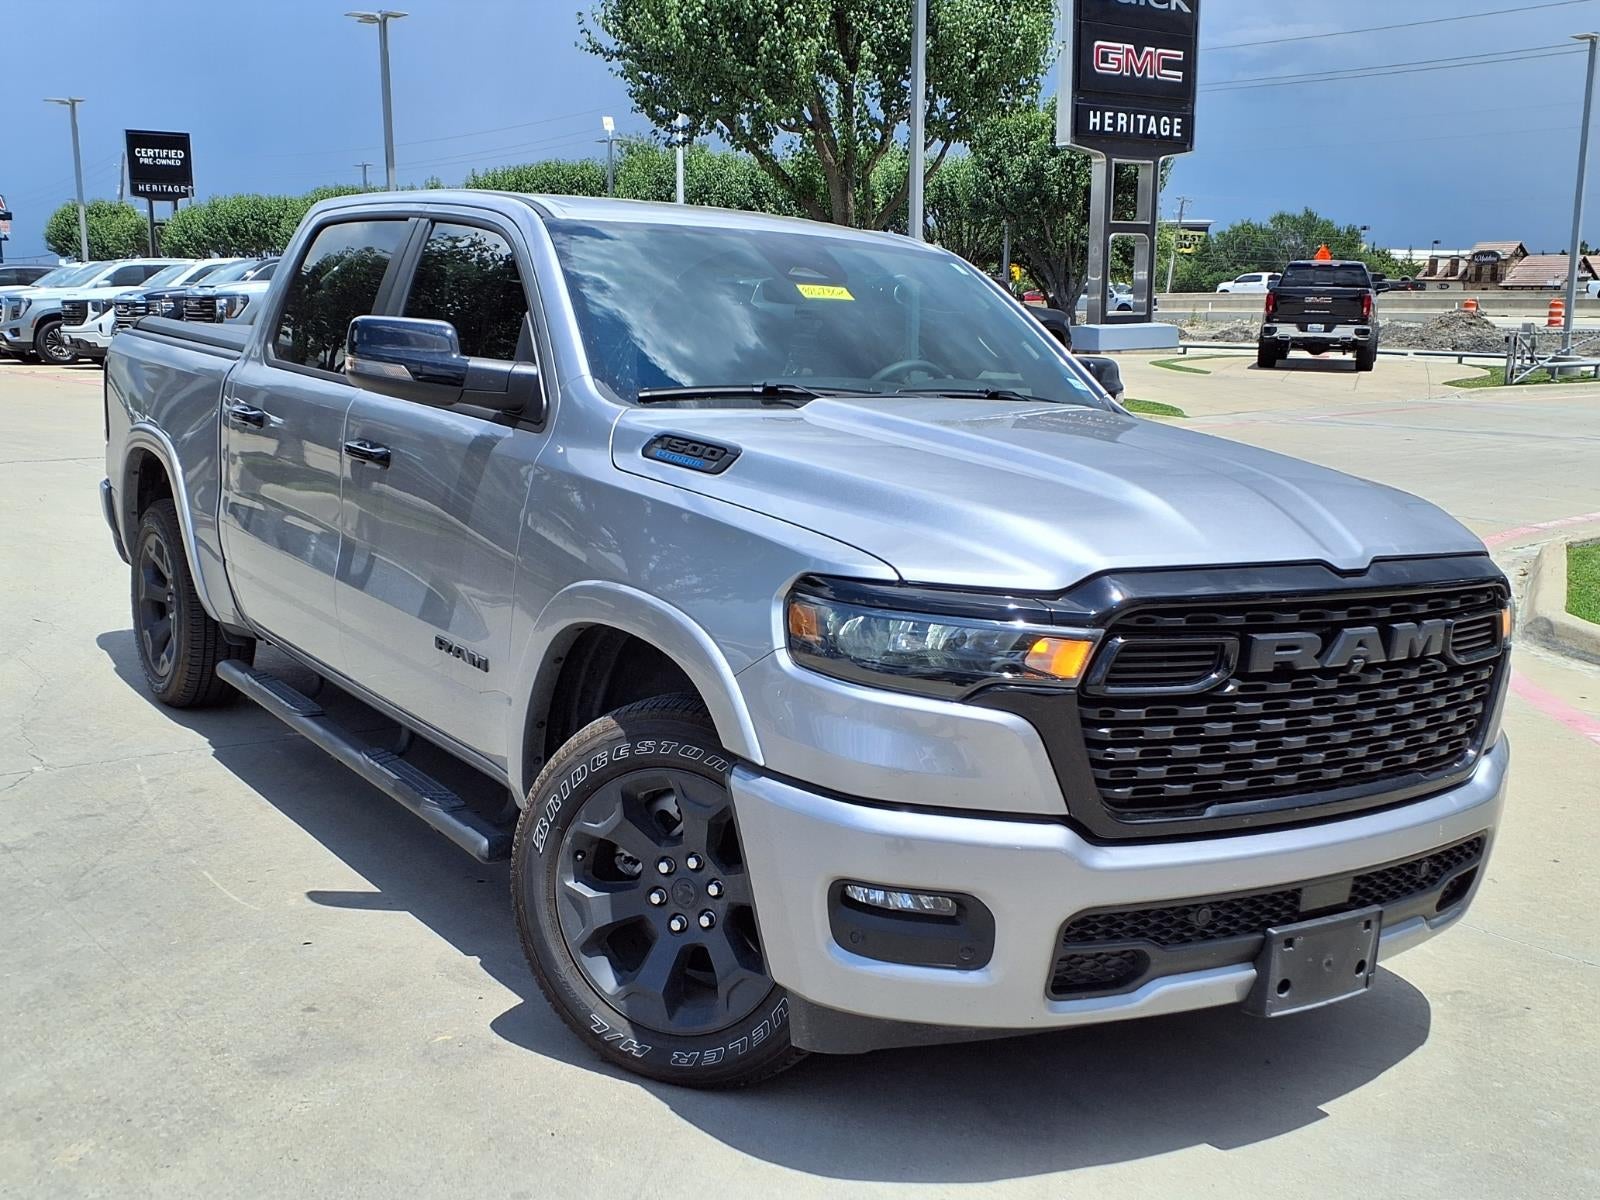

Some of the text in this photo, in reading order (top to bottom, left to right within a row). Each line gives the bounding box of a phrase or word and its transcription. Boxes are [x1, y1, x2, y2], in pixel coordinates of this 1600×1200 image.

[1093, 41, 1184, 82] GMC
[1089, 110, 1183, 137] HERITAGE
[135, 148, 185, 158] CERTIFIED
[139, 158, 181, 166] PRE-OWNED
[138, 184, 187, 193] HERITAGE
[653, 437, 727, 461] 1500
[434, 634, 489, 673] RAM
[1248, 618, 1446, 673] RAM
[532, 740, 730, 854] BRIDGESTON
[589, 997, 789, 1067] UELER H/L
